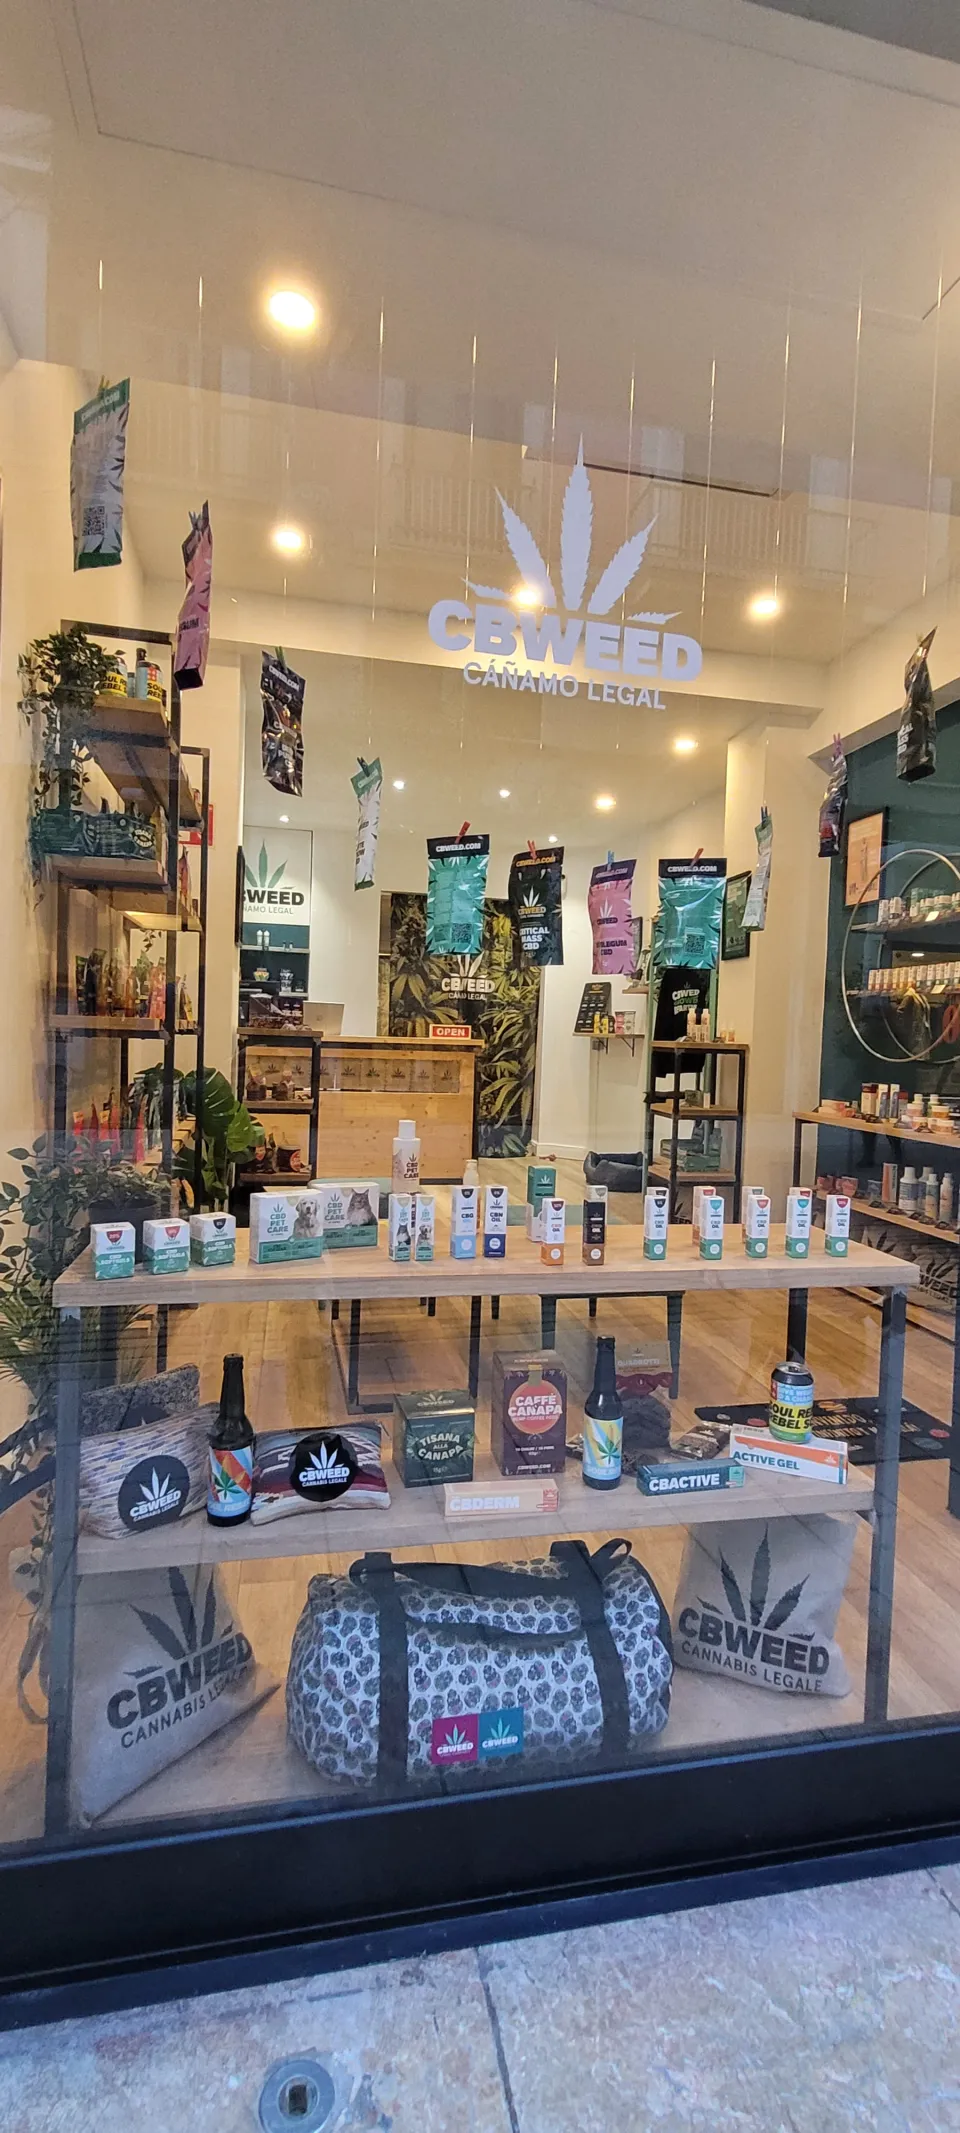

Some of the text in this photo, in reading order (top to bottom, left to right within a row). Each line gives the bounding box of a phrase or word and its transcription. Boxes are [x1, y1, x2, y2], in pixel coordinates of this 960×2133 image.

[428, 599, 704, 683] CBWEED
[463, 658, 667, 710] CÁÑAMO LEGAL
[435, 842, 482, 853] CBWEED.COM
[522, 942, 540, 950] CBD
[436, 1028, 466, 1037] OPEN
[267, 1226, 289, 1234] CARE
[770, 1402, 796, 1418] OUL
[771, 1414, 801, 1429] EBEL
[419, 1432, 460, 1447] TISANA
[432, 1442, 449, 1450] ALLA
[418, 1444, 464, 1461] CANAPA
[731, 1451, 800, 1470] ACTIVE GEL
[298, 1466, 350, 1482] CBWEED
[648, 1472, 720, 1492] CBACTIVE
[129, 1489, 182, 1518] CBWEED
[449, 1495, 521, 1512] CBDERM
[678, 1607, 830, 1676] CBWEED
[681, 1640, 823, 1693] CANNABIS LEGALE
[106, 1631, 253, 1730] CBWEED
[120, 1696, 206, 1749] CANNABIS
[436, 1742, 474, 1755] CBWEED
[481, 1735, 519, 1749] CBWEED
